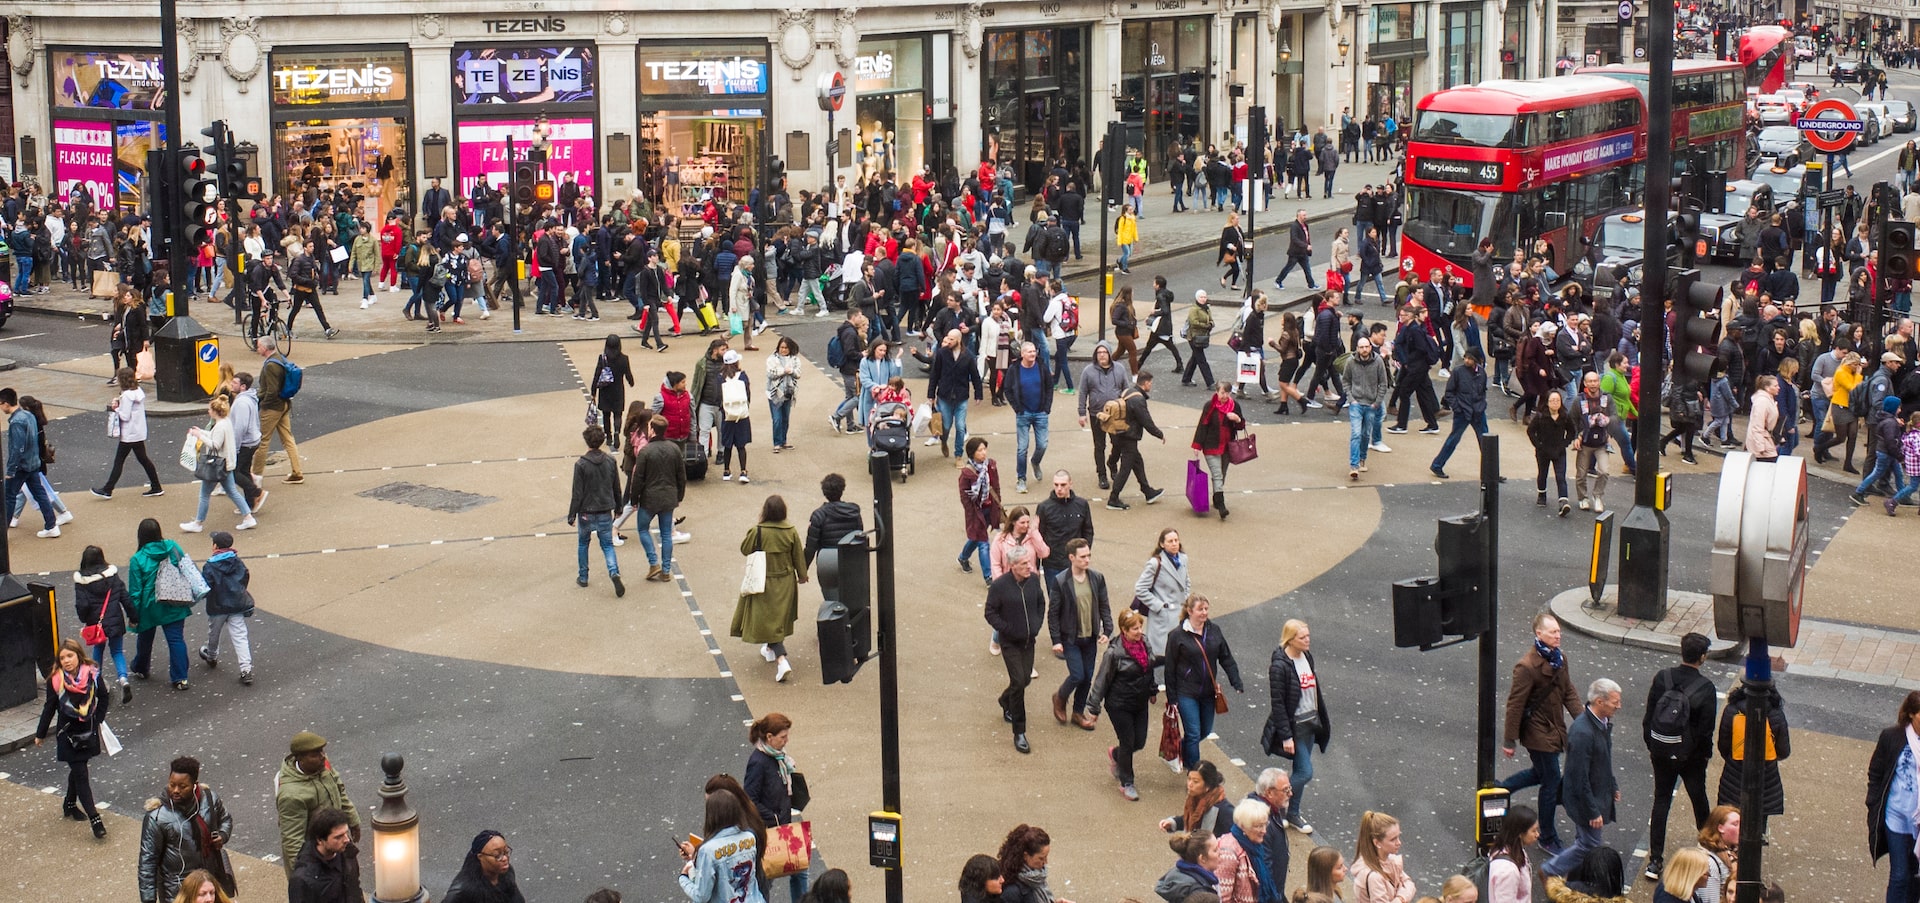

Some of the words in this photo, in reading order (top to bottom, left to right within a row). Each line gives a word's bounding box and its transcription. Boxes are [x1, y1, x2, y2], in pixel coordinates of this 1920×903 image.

[1040, 3, 1060, 13] KIKO
[1162, 1, 1179, 10] OMEGA
[471, 70, 494, 82] TE
[512, 69, 535, 81] ZE
[1800, 121, 1861, 130] UNDERGROUND
[60, 150, 87, 165] FLASH
[90, 152, 112, 167] SALE
[1544, 157, 1560, 172] MAKE
[1561, 152, 1583, 168] MONDAY
[1583, 147, 1598, 163] GREAT
[1423, 162, 1469, 173] Marylebone
[1480, 165, 1498, 179] 453
[58, 180, 68, 197] UP
[874, 832, 896, 841] WAIT
